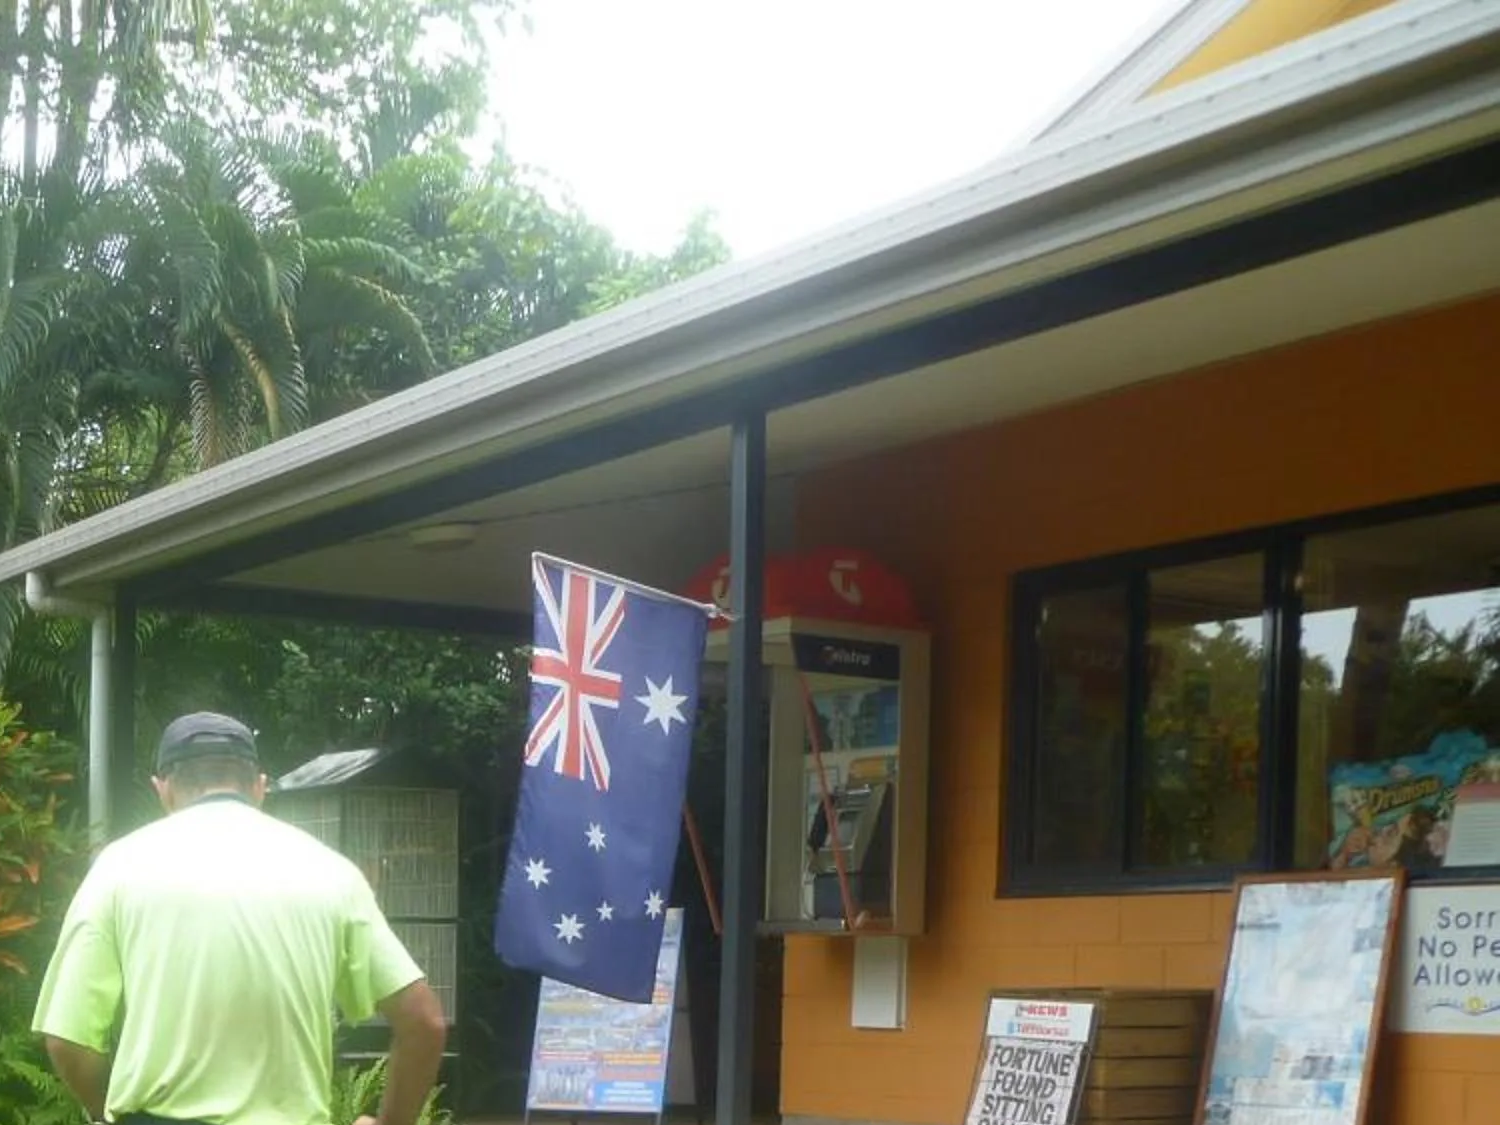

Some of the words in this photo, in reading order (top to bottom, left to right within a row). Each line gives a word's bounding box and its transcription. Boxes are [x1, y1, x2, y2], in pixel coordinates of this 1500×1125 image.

[1419, 935, 1458, 957] No
[1413, 963, 1500, 986] Allow
[989, 1044, 1077, 1077] FORTUNE
[991, 1069, 1057, 1100] FOUND
[981, 1093, 1055, 1125] SITTING
